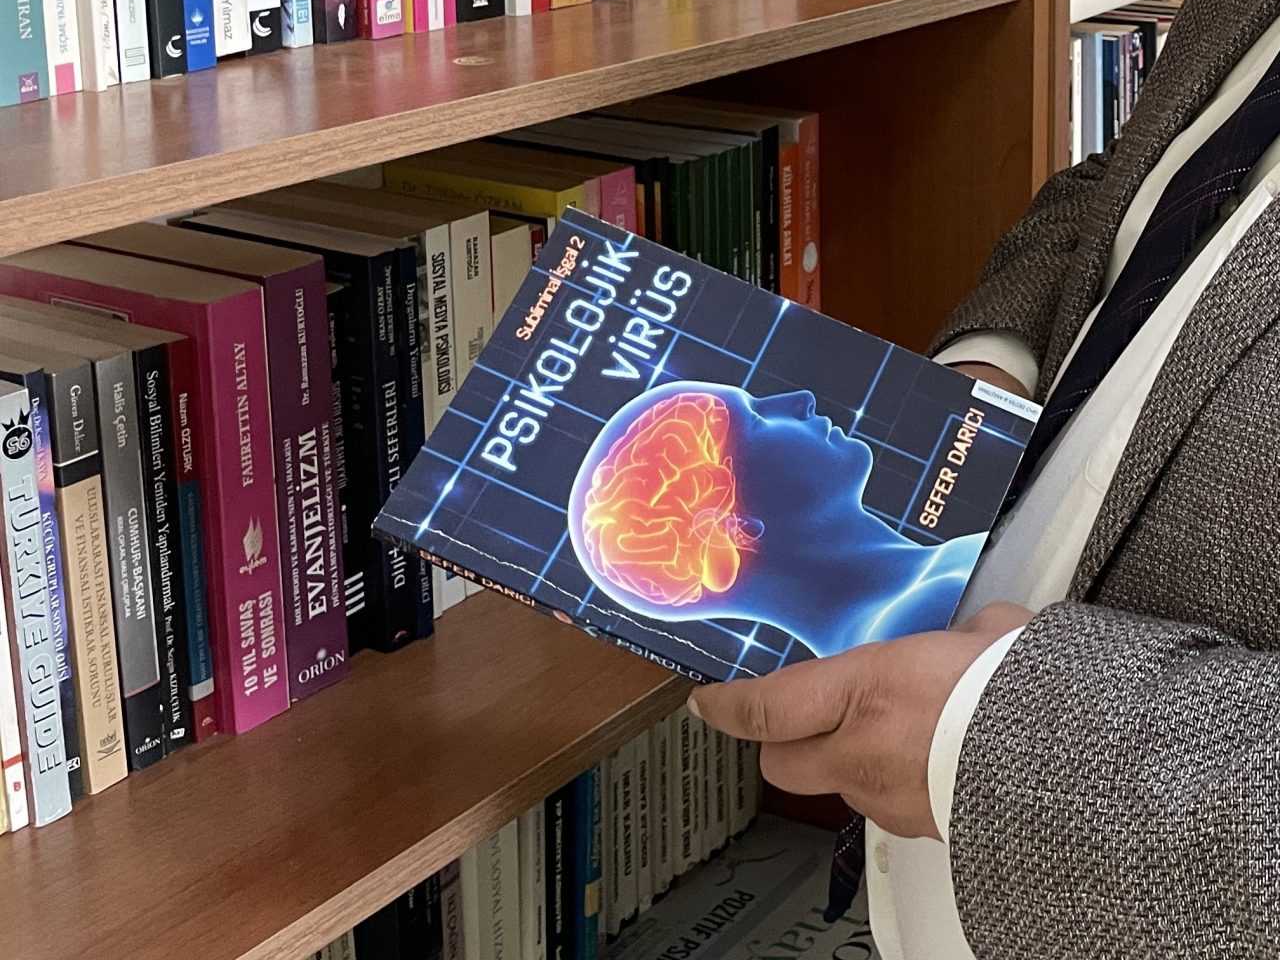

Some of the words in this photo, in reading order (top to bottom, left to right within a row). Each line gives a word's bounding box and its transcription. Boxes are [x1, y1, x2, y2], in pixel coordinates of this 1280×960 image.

[431, 251, 447, 296] SOSYAL
[515, 273, 561, 341] Subliminal
[549, 247, 581, 282] İşgal
[570, 235, 586, 249] 2
[295, 288, 306, 345] KURTOĞLU
[434, 296, 449, 335] MEDYA
[600, 264, 693, 380] VİRÜS
[233, 341, 247, 393] ALTAY
[300, 344, 309, 390] Ramazan
[437, 335, 455, 397] PSİKOLOJİSİ
[480, 239, 641, 473] PSİKOLOJİK
[112, 382, 126, 416] Halis
[145, 370, 159, 413] Sosyal
[113, 416, 128, 448] Çetin
[149, 414, 165, 469] Bilimleri
[236, 395, 254, 487] FAHRETTİN
[381, 380, 401, 465] SEFERLERİ
[919, 466, 959, 529] SEFER
[946, 406, 986, 467] DARICI
[75, 515, 86, 530] VE
[154, 471, 169, 522] Yeniden
[296, 426, 327, 620] EVANJELİZM
[42, 511, 54, 553] KÜÇÜK
[86, 486, 107, 580] ULUSLARARASI
[8, 478, 49, 648] TÜRKİYE
[46, 555, 61, 608] GRUPLAR
[77, 534, 92, 593] FİNANSAL
[127, 507, 147, 620] CUMHUR-BAŞKANI
[156, 524, 173, 612] Yapılandırmak
[94, 582, 109, 641] FİNANSAL
[238, 599, 256, 647] SAVAŞ
[258, 590, 277, 661] SONRASI
[87, 657, 102, 709] SORUNU
[240, 649, 256, 671] YIL
[244, 673, 259, 696] 10
[263, 664, 278, 688] VE
[298, 649, 346, 683] ORION
[27, 653, 62, 775] GUIDE
